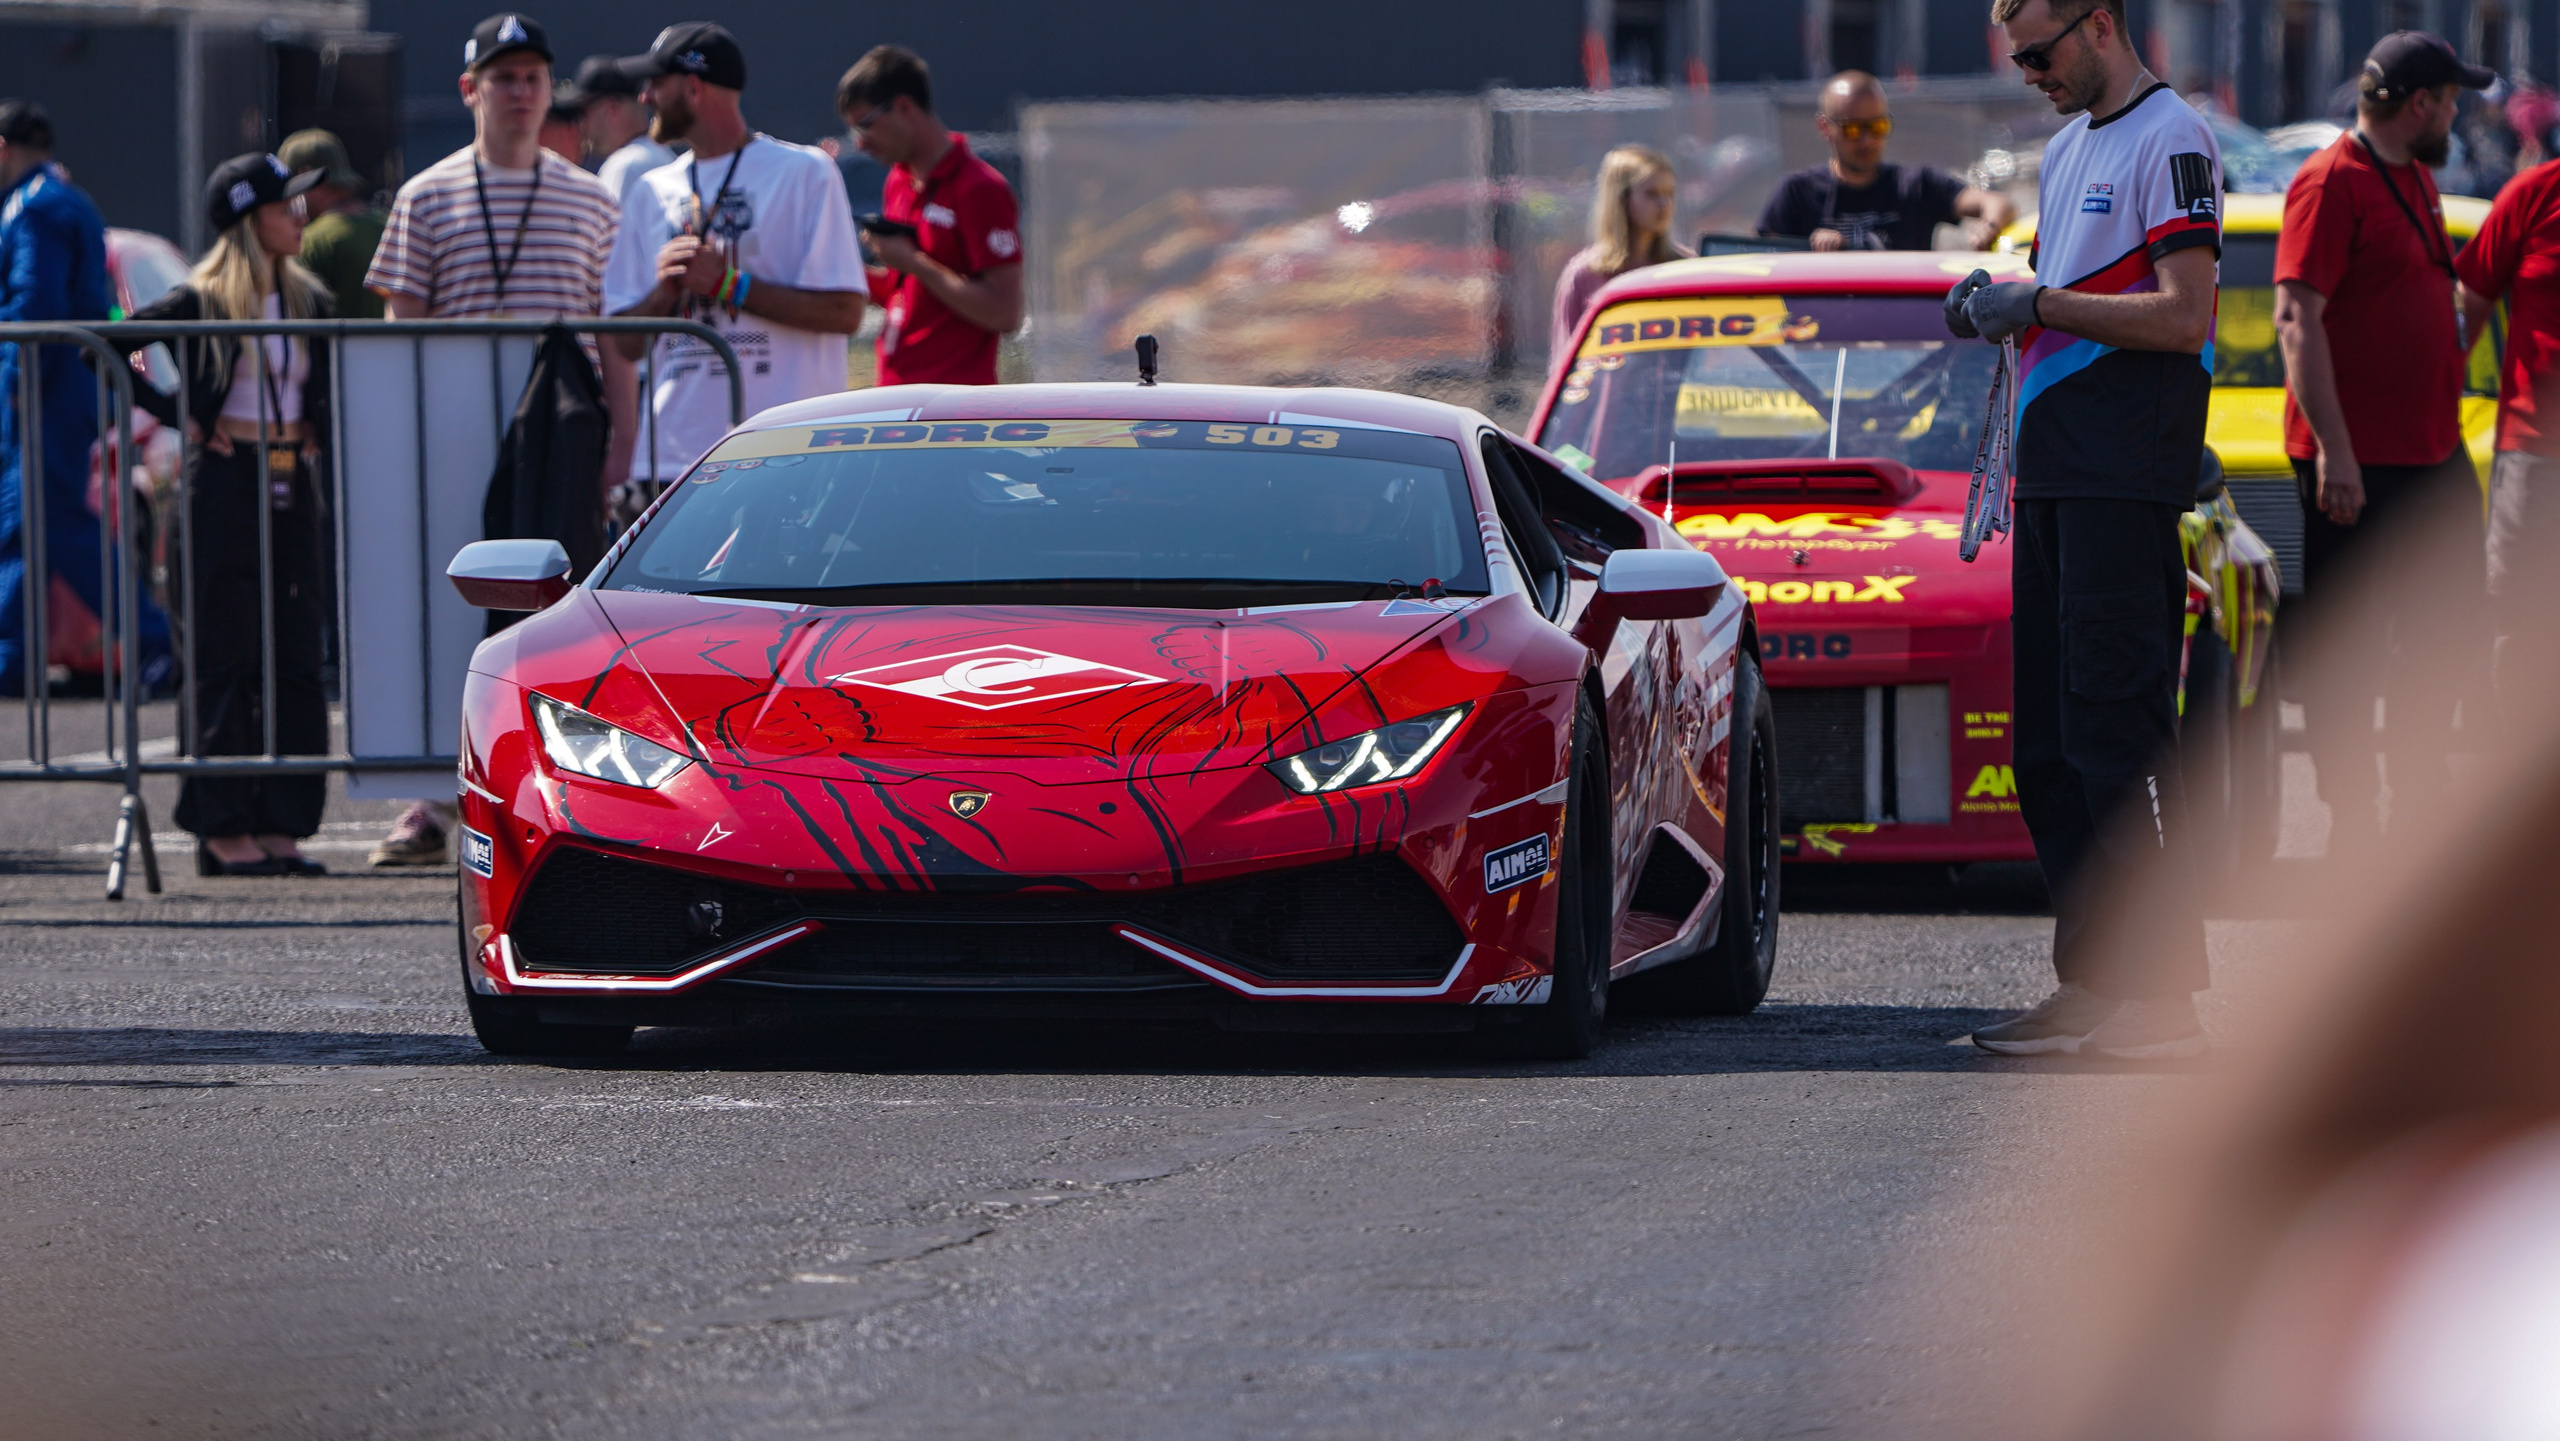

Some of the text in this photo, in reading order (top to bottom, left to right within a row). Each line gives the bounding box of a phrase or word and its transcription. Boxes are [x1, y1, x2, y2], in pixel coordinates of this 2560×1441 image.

[1600, 314, 1756, 346] RDRC
[808, 423, 1341, 449] RDRC 503
[1489, 844, 1546, 885] AIMOL
